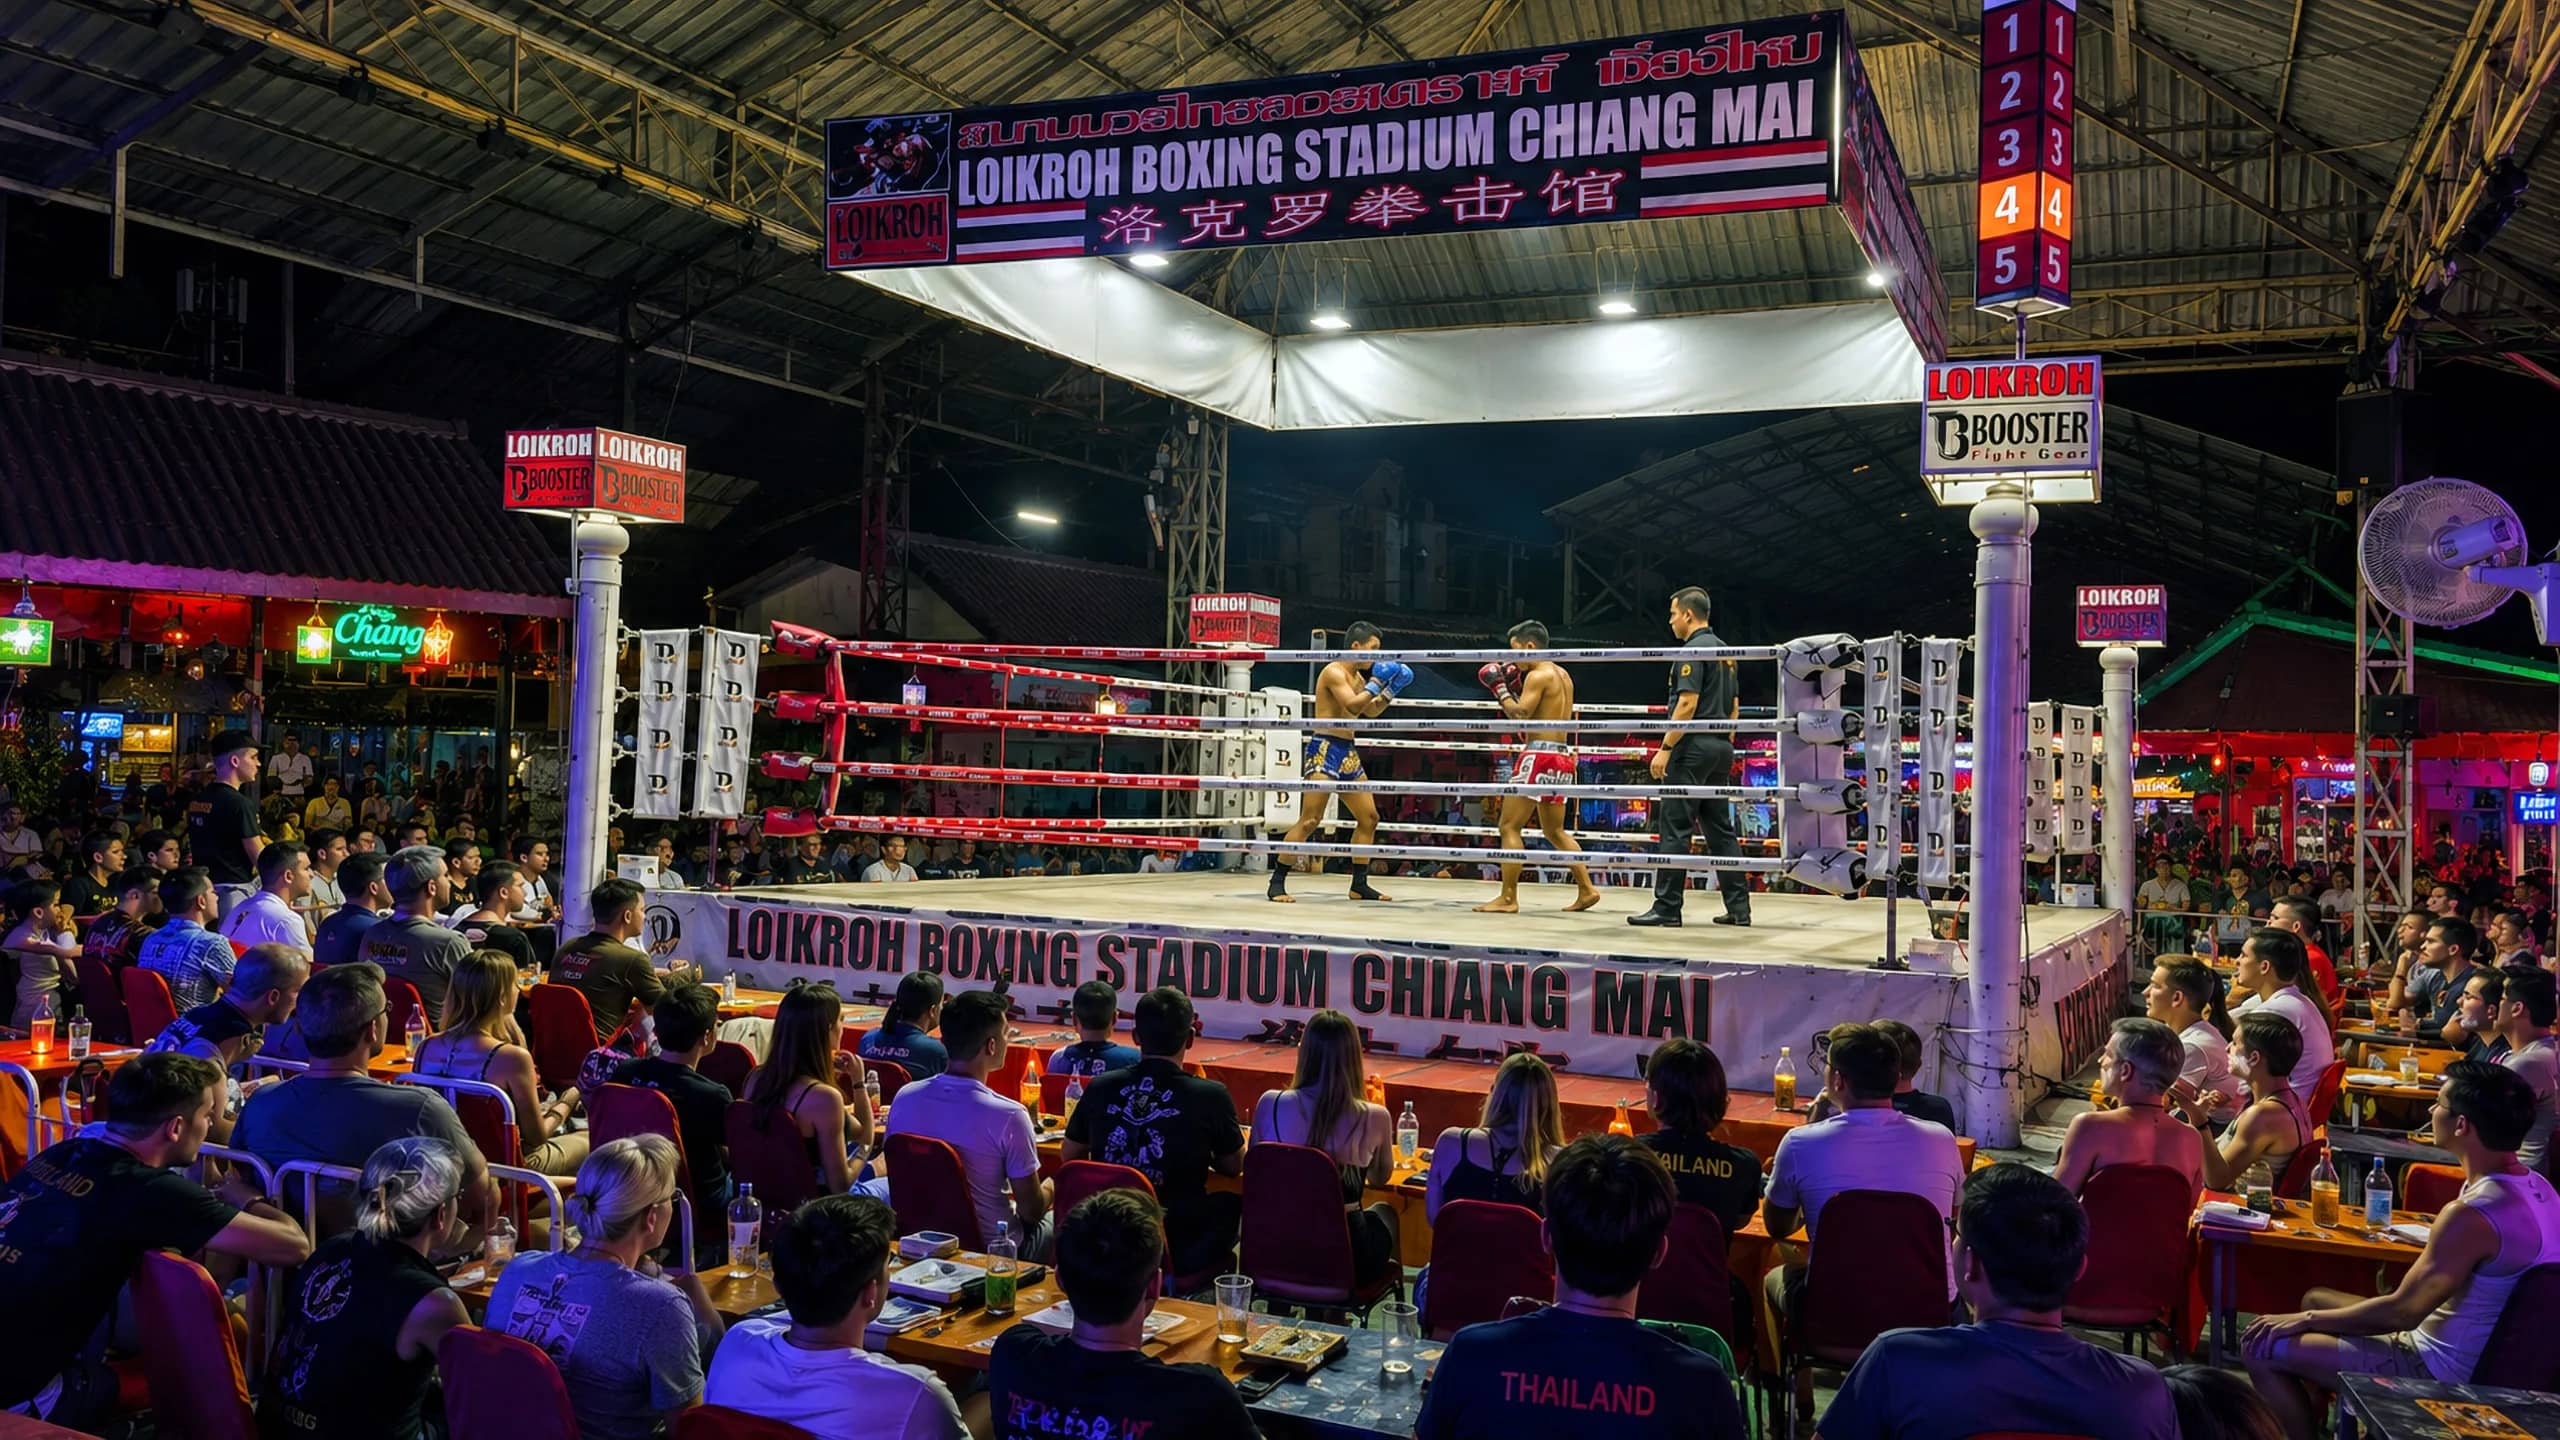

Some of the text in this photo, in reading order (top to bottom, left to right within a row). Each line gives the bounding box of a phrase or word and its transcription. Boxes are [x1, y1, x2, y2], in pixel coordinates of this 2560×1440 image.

[2002, 13, 2019, 53] 1
[2055, 15, 2064, 54] 1
[1999, 71, 2021, 111] 2
[2053, 71, 2064, 111] 2
[958, 79, 1814, 206] LOIKROH BOXING STADIUM CHIANG MAI
[1998, 129, 2020, 168] 3
[2050, 127, 2062, 167] 3
[836, 201, 943, 244] LOIKROH
[1098, 168, 1626, 246] 洛克罗拳击馆
[1995, 185, 2020, 225] 4
[2048, 187, 2062, 227] 4
[1994, 245, 2016, 285] 5
[2047, 247, 2061, 284] 5
[1927, 362, 2095, 401] LOIKROH
[507, 433, 592, 458] LOIKROH
[1971, 411, 2090, 446] BOOSTER
[599, 433, 682, 472] LOIKROH
[1971, 447, 2089, 462] Fight Gear
[529, 466, 591, 491] BOOSTER
[621, 474, 680, 505] BOOSTER
[2079, 588, 2160, 606] LOIKROH
[335, 612, 426, 654] Chang
[727, 907, 905, 973] LOIKROH
[919, 922, 1080, 988] BOXING
[1096, 933, 1328, 1010] STADIUM
[1351, 949, 1571, 1032] CHIANG
[1592, 968, 1713, 1044] MAI
[1655, 1152, 1734, 1179] AILAND
[1500, 1371, 1656, 1416] THAILAND
